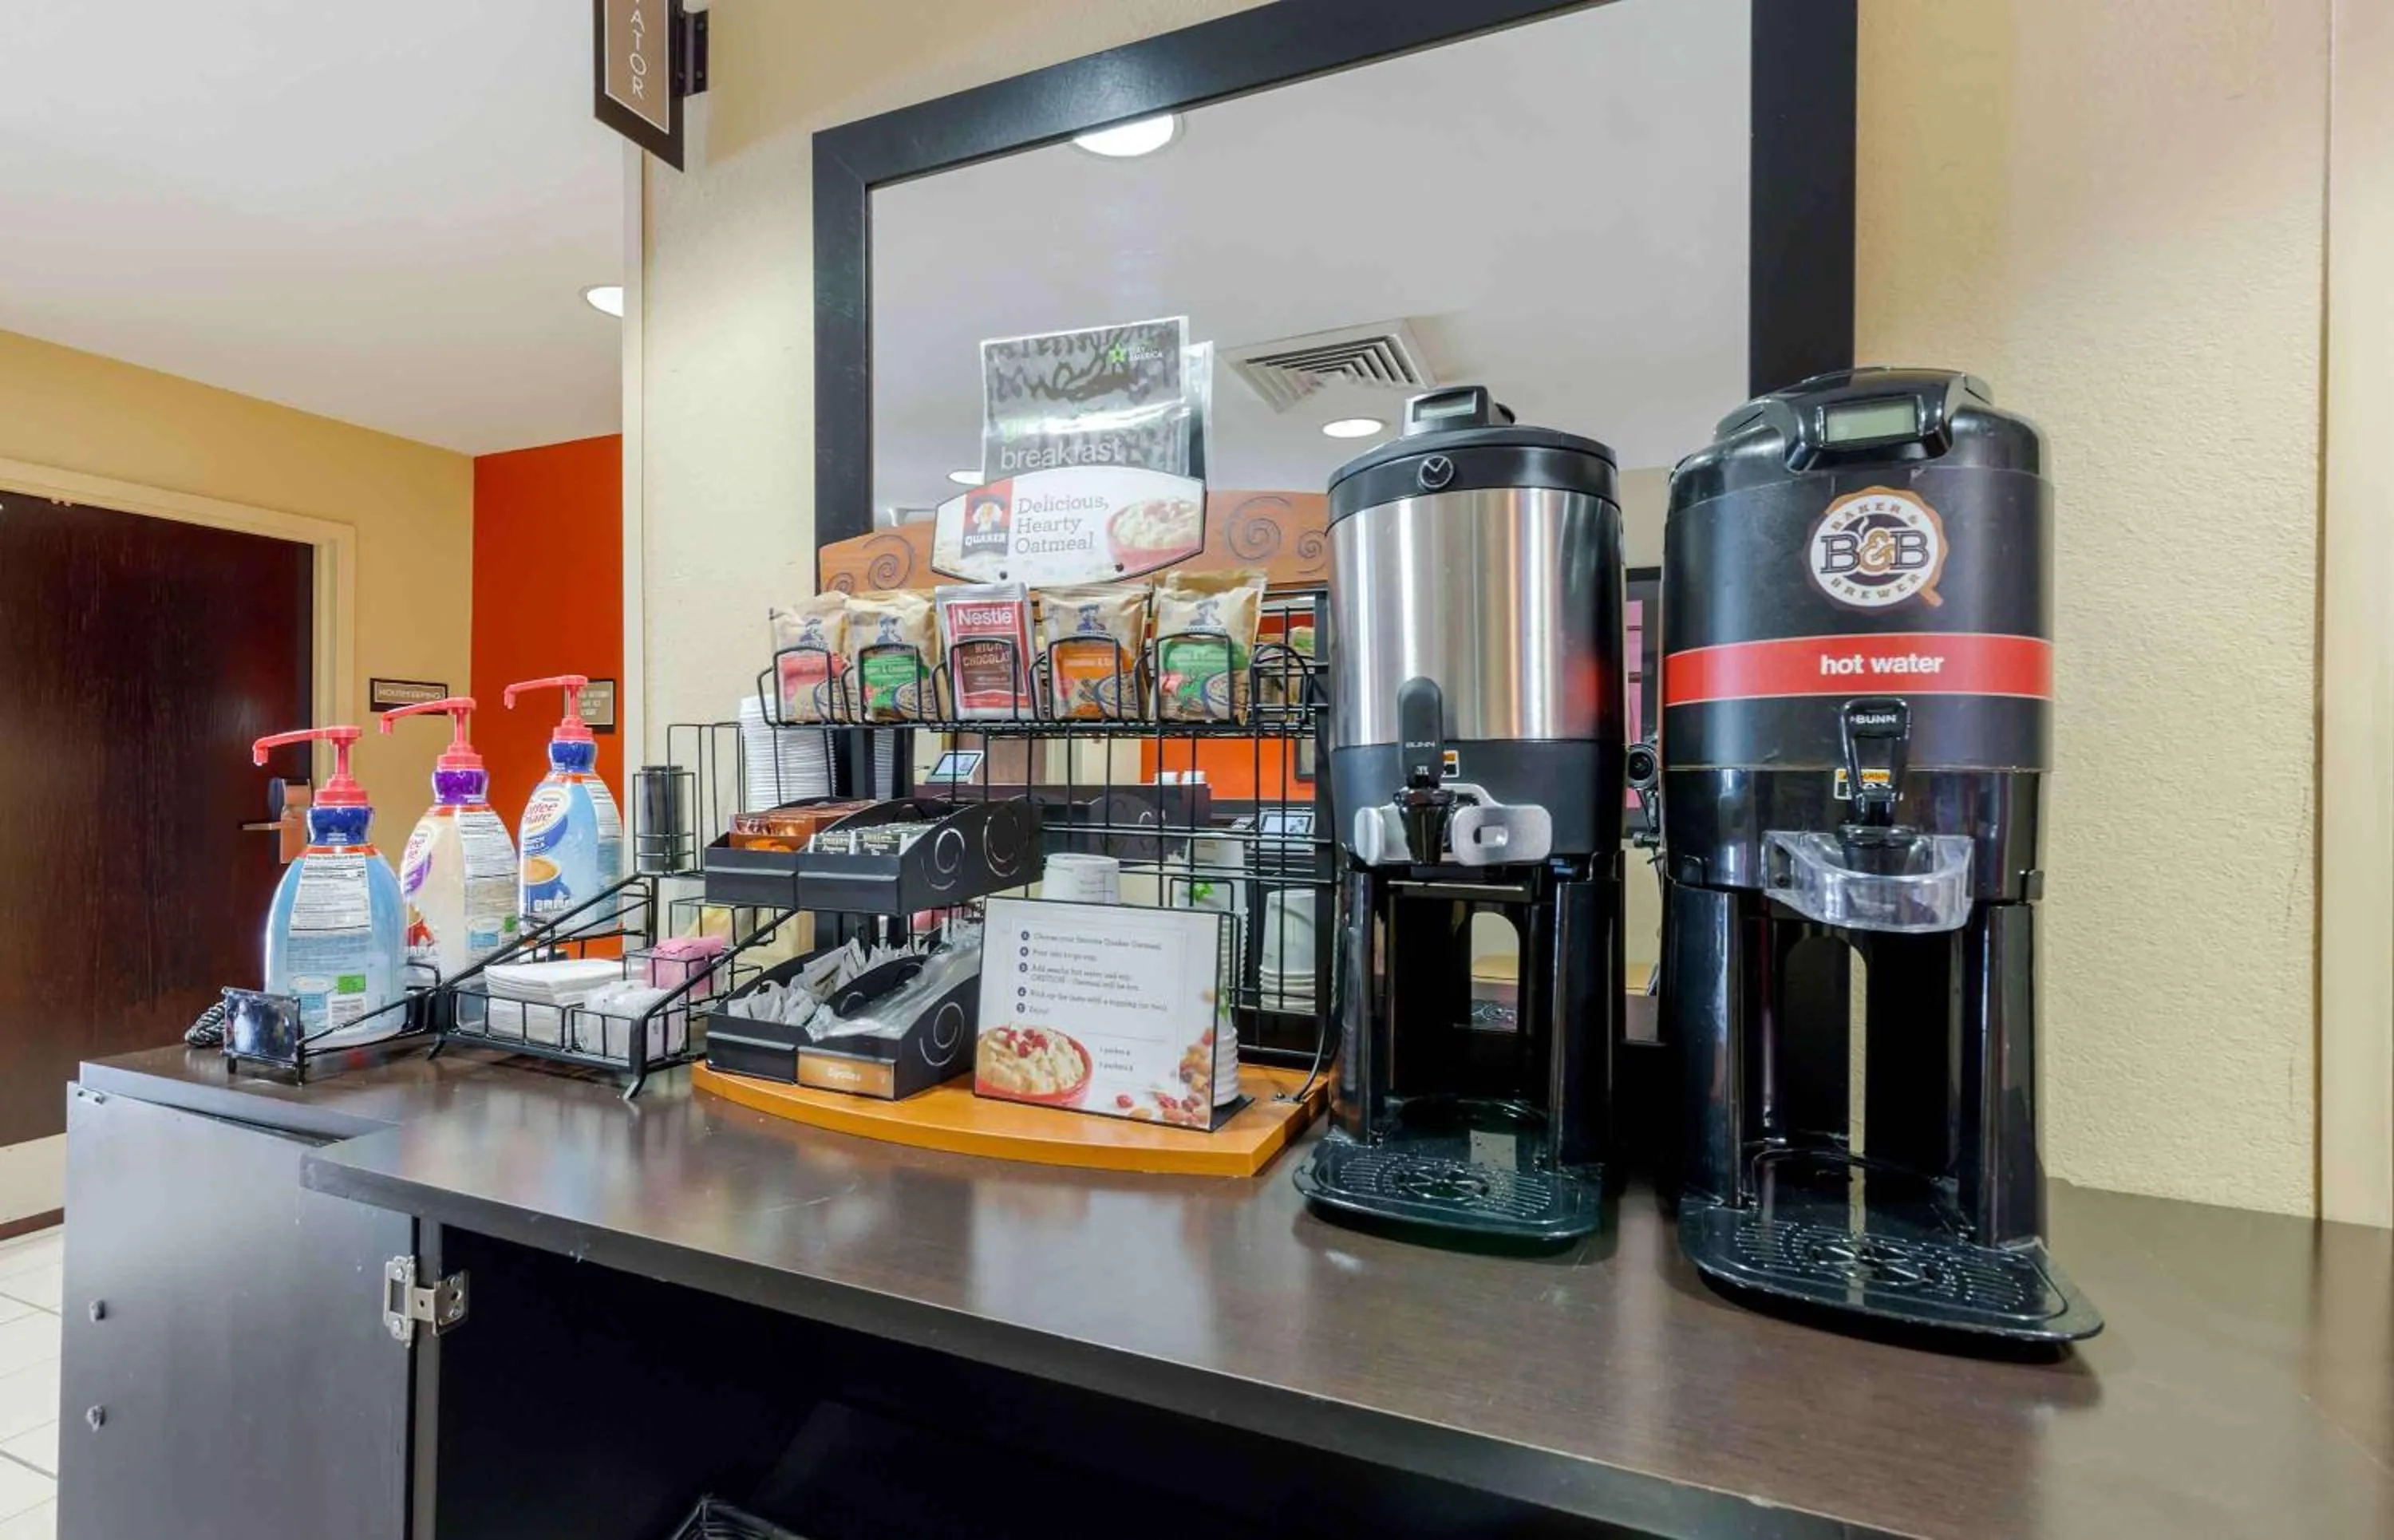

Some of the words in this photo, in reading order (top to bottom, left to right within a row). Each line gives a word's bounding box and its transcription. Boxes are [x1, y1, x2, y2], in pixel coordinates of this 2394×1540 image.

[630, 0, 647, 100] ATOR
[1000, 437, 1126, 471] breakfast
[1018, 494, 1109, 515] Delicious,
[1017, 518, 1082, 535] Hearty
[1015, 532, 1094, 555] Oatmeal
[1820, 654, 1864, 675] hot
[1871, 654, 1945, 673] water
[1855, 714, 1897, 724] BUNN
